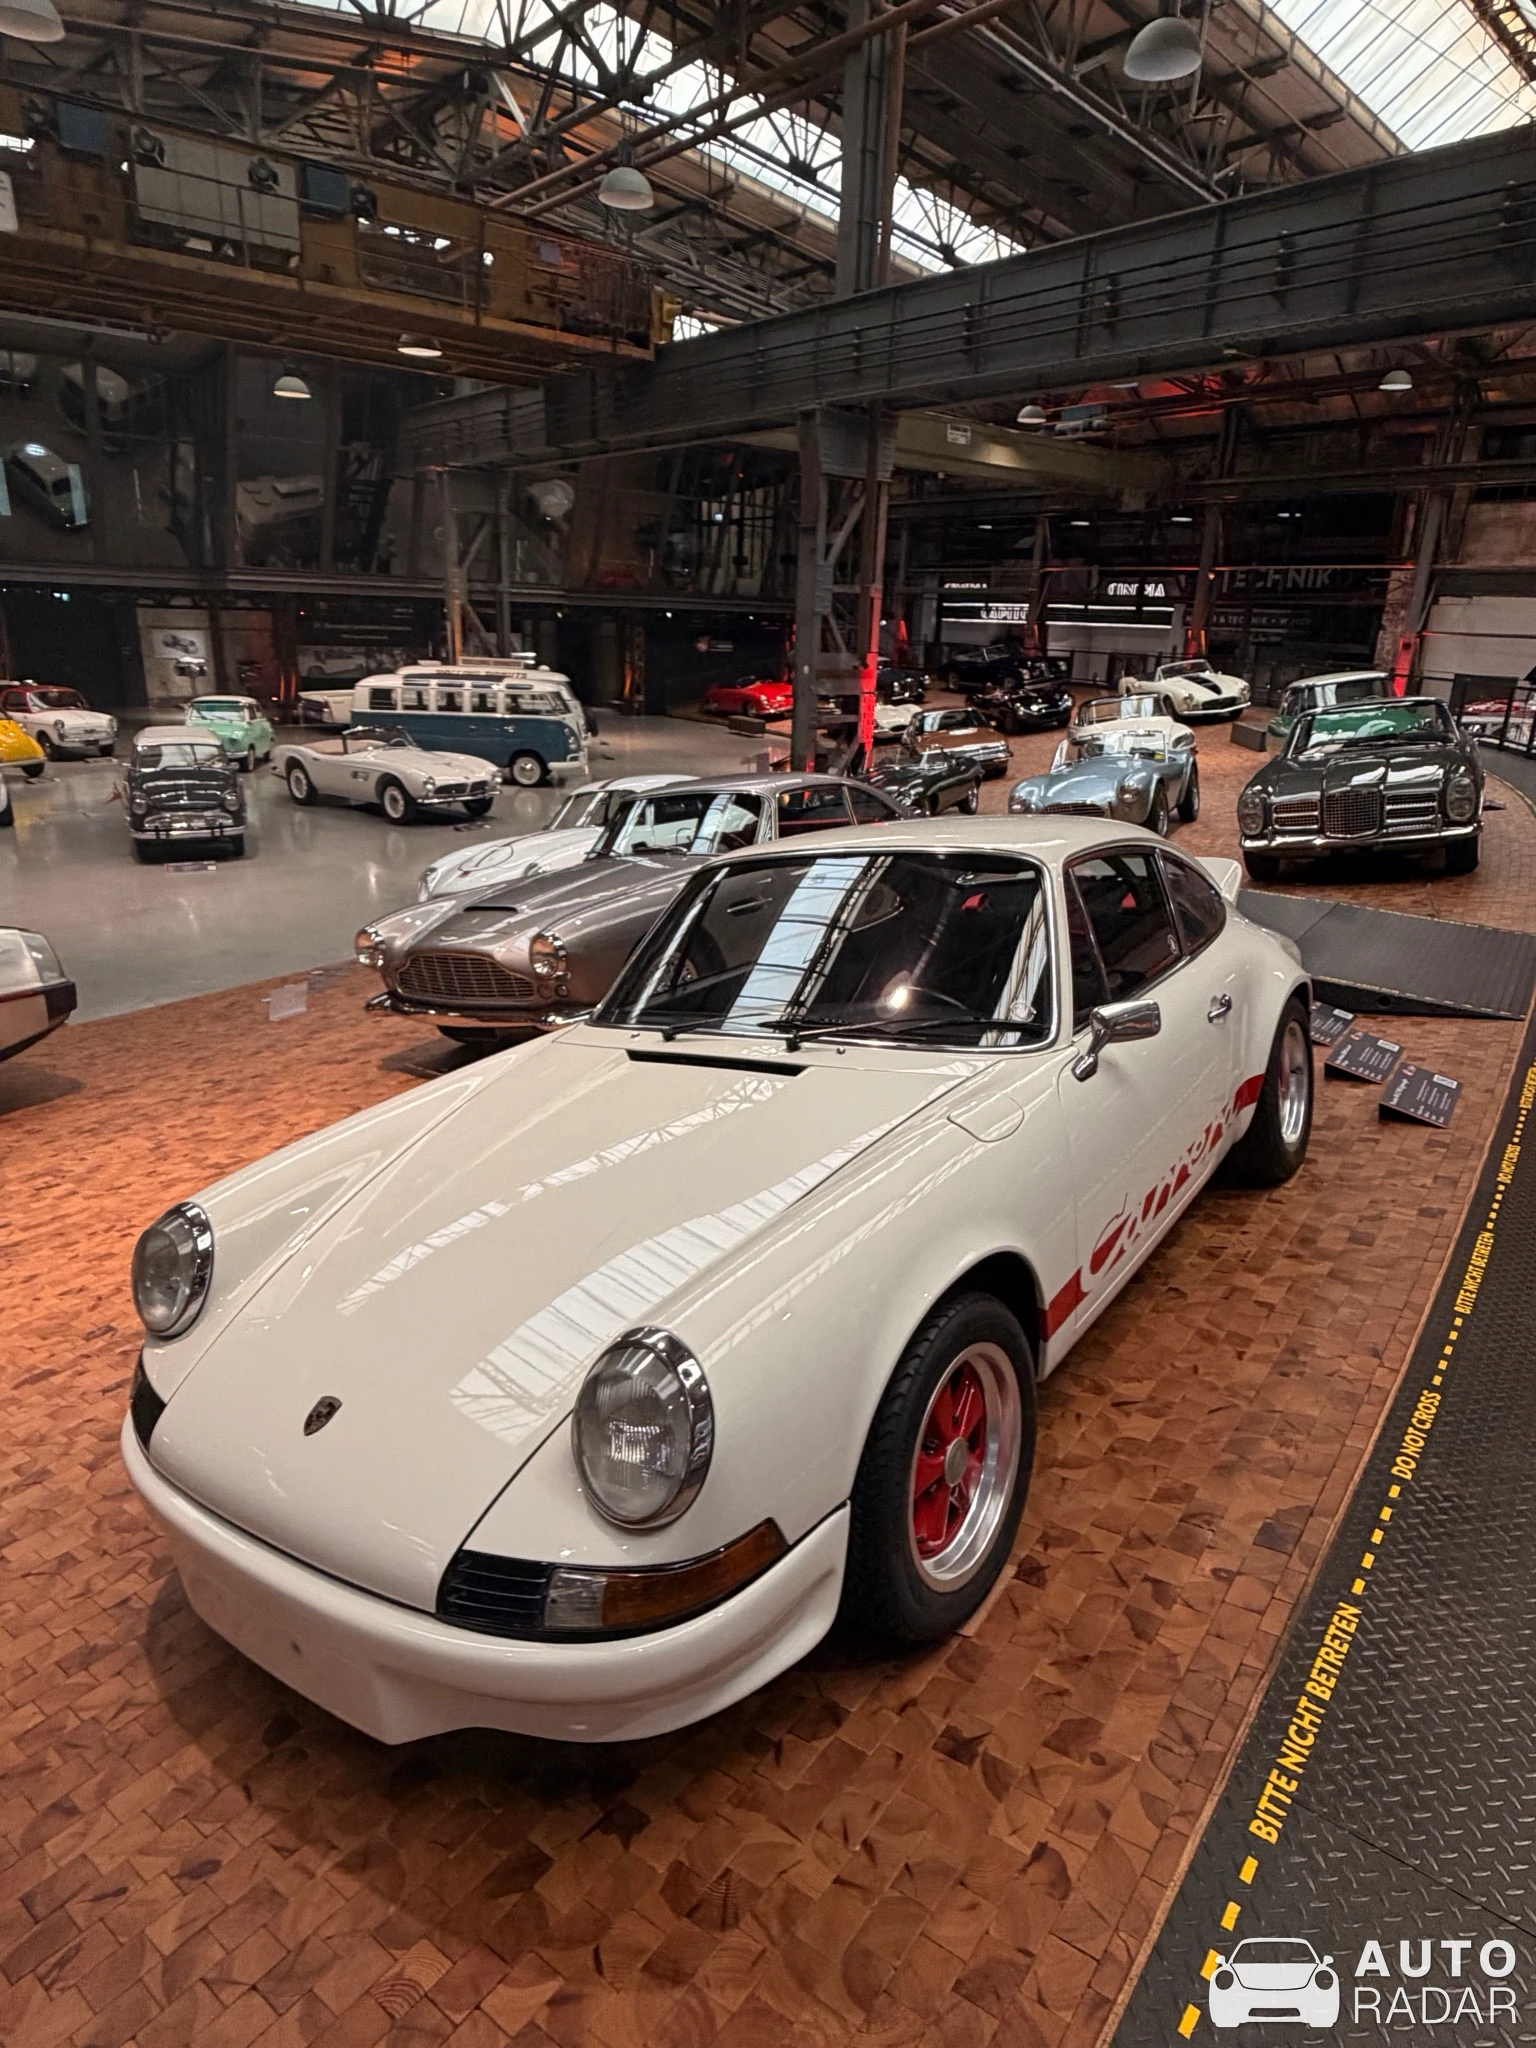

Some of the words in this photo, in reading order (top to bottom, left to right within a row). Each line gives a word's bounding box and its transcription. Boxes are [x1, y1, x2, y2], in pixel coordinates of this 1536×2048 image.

[1470, 1231, 1495, 1269] BETRETEN
[1462, 1264, 1485, 1294] NICHT
[1454, 1288, 1476, 1314] BITTE
[1411, 1389, 1442, 1430] CROSS
[1399, 1426, 1428, 1458] NOT
[1391, 1456, 1416, 1480] DO
[1249, 1768, 1299, 1845] BITTE
[1275, 1695, 1328, 1774] NICHT
[1304, 1602, 1362, 1702] BETRETEN
